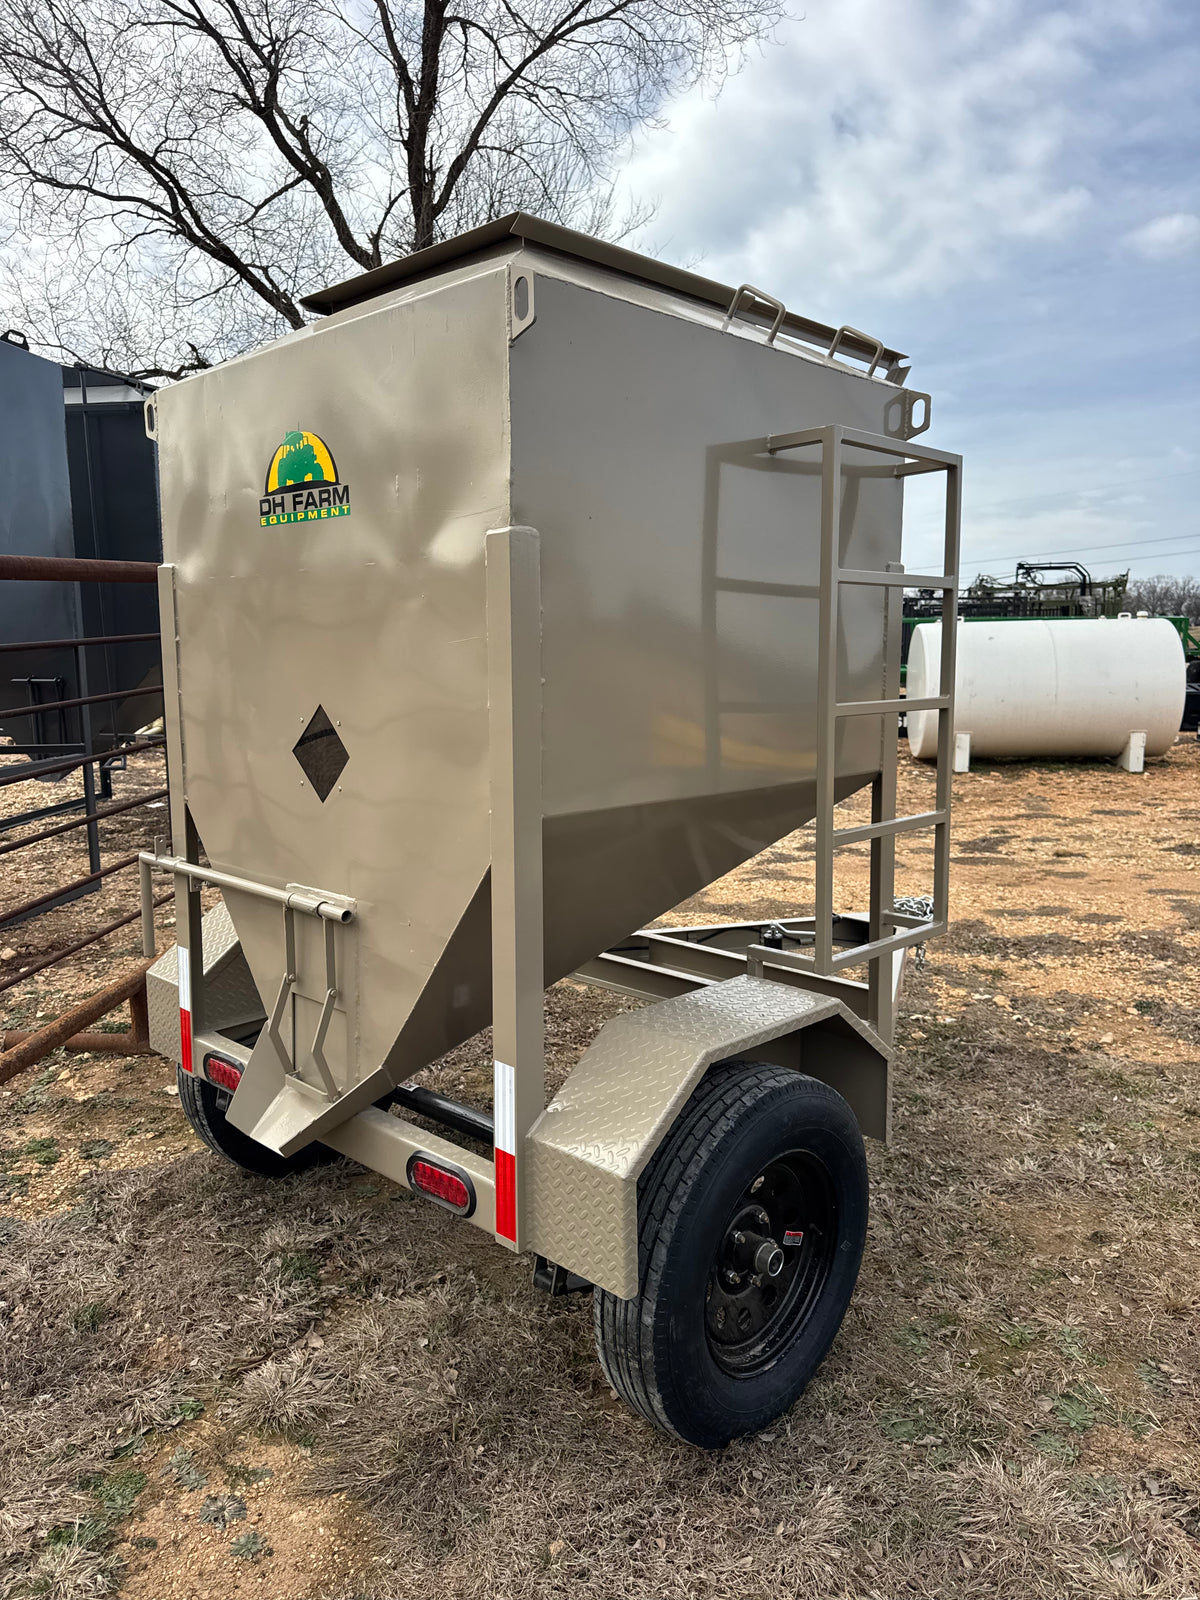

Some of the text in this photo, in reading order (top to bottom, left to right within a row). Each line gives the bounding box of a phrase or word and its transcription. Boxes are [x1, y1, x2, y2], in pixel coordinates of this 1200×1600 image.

[259, 485, 350, 516] DH FARM
[260, 505, 350, 526] EQUIPMENT
